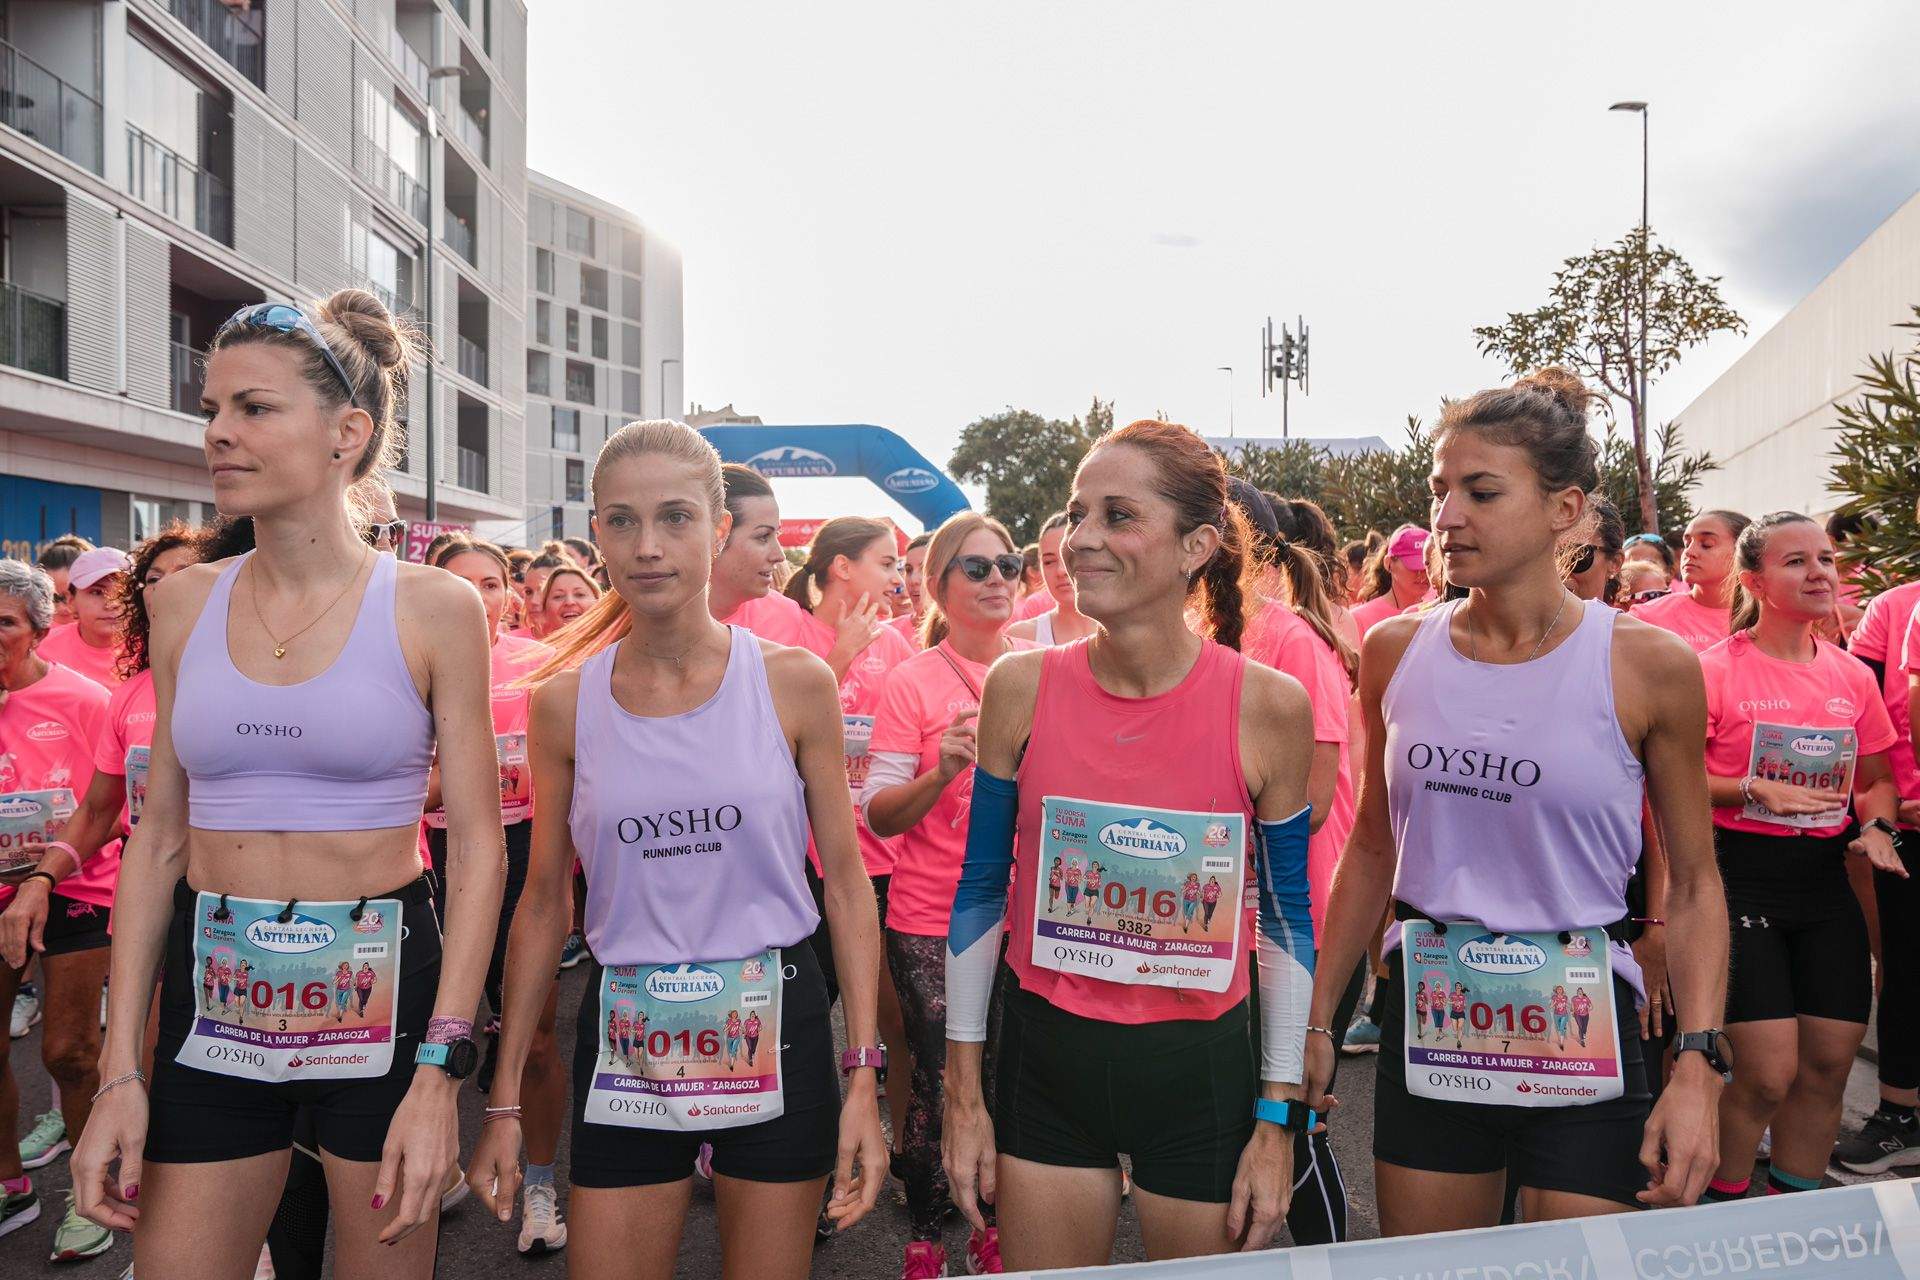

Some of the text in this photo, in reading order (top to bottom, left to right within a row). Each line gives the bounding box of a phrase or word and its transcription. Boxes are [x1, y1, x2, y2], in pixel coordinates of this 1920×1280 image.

[1739, 699, 1791, 712] OYSHO
[236, 722, 303, 739] OYSHO
[1407, 743, 1542, 787] OYSHO
[1791, 771, 1830, 788] 016
[1424, 780, 1512, 803] RUNNING CLUB
[617, 804, 742, 844] OYSHO
[1055, 815, 1086, 828] SUMA
[1061, 830, 1088, 840] Zaragoza
[1104, 829, 1181, 853] ASTURIANA
[642, 842, 722, 859] RUNNING CLUB
[1103, 881, 1177, 918] 016
[251, 926, 329, 943] ASTURIANA
[1117, 919, 1152, 936] 9382
[1056, 926, 1213, 954] CARRERA DE LA MUJER ZARAGOZA
[1415, 938, 1445, 949] SUMA
[1054, 946, 1114, 968] OYSHO
[1463, 948, 1541, 965] ASTURIANA
[614, 966, 637, 977] SUMA
[1152, 964, 1212, 978] Santander
[648, 976, 719, 993] ASTURIANA
[251, 980, 328, 1010] 016
[278, 1020, 287, 1031] 3
[1470, 1002, 1547, 1034] 016
[215, 1024, 370, 1044] CARRERA DE LA MUJER ZARAGOZA
[647, 1029, 720, 1057] 016
[1501, 1040, 1510, 1053] 7
[206, 1045, 265, 1067] OYSHO
[304, 1054, 369, 1066] Santander
[1427, 1052, 1595, 1072] CARRERA DE LA MUJER ZARAGOZA
[676, 1066, 686, 1078] 4
[614, 1077, 760, 1093] CARRERA DE LA MUJER ZARAGOZA
[1429, 1072, 1491, 1091] OYSHO
[1534, 1083, 1598, 1097] Santander
[609, 1098, 667, 1116] OYSHO
[703, 1102, 761, 1116] Santander
